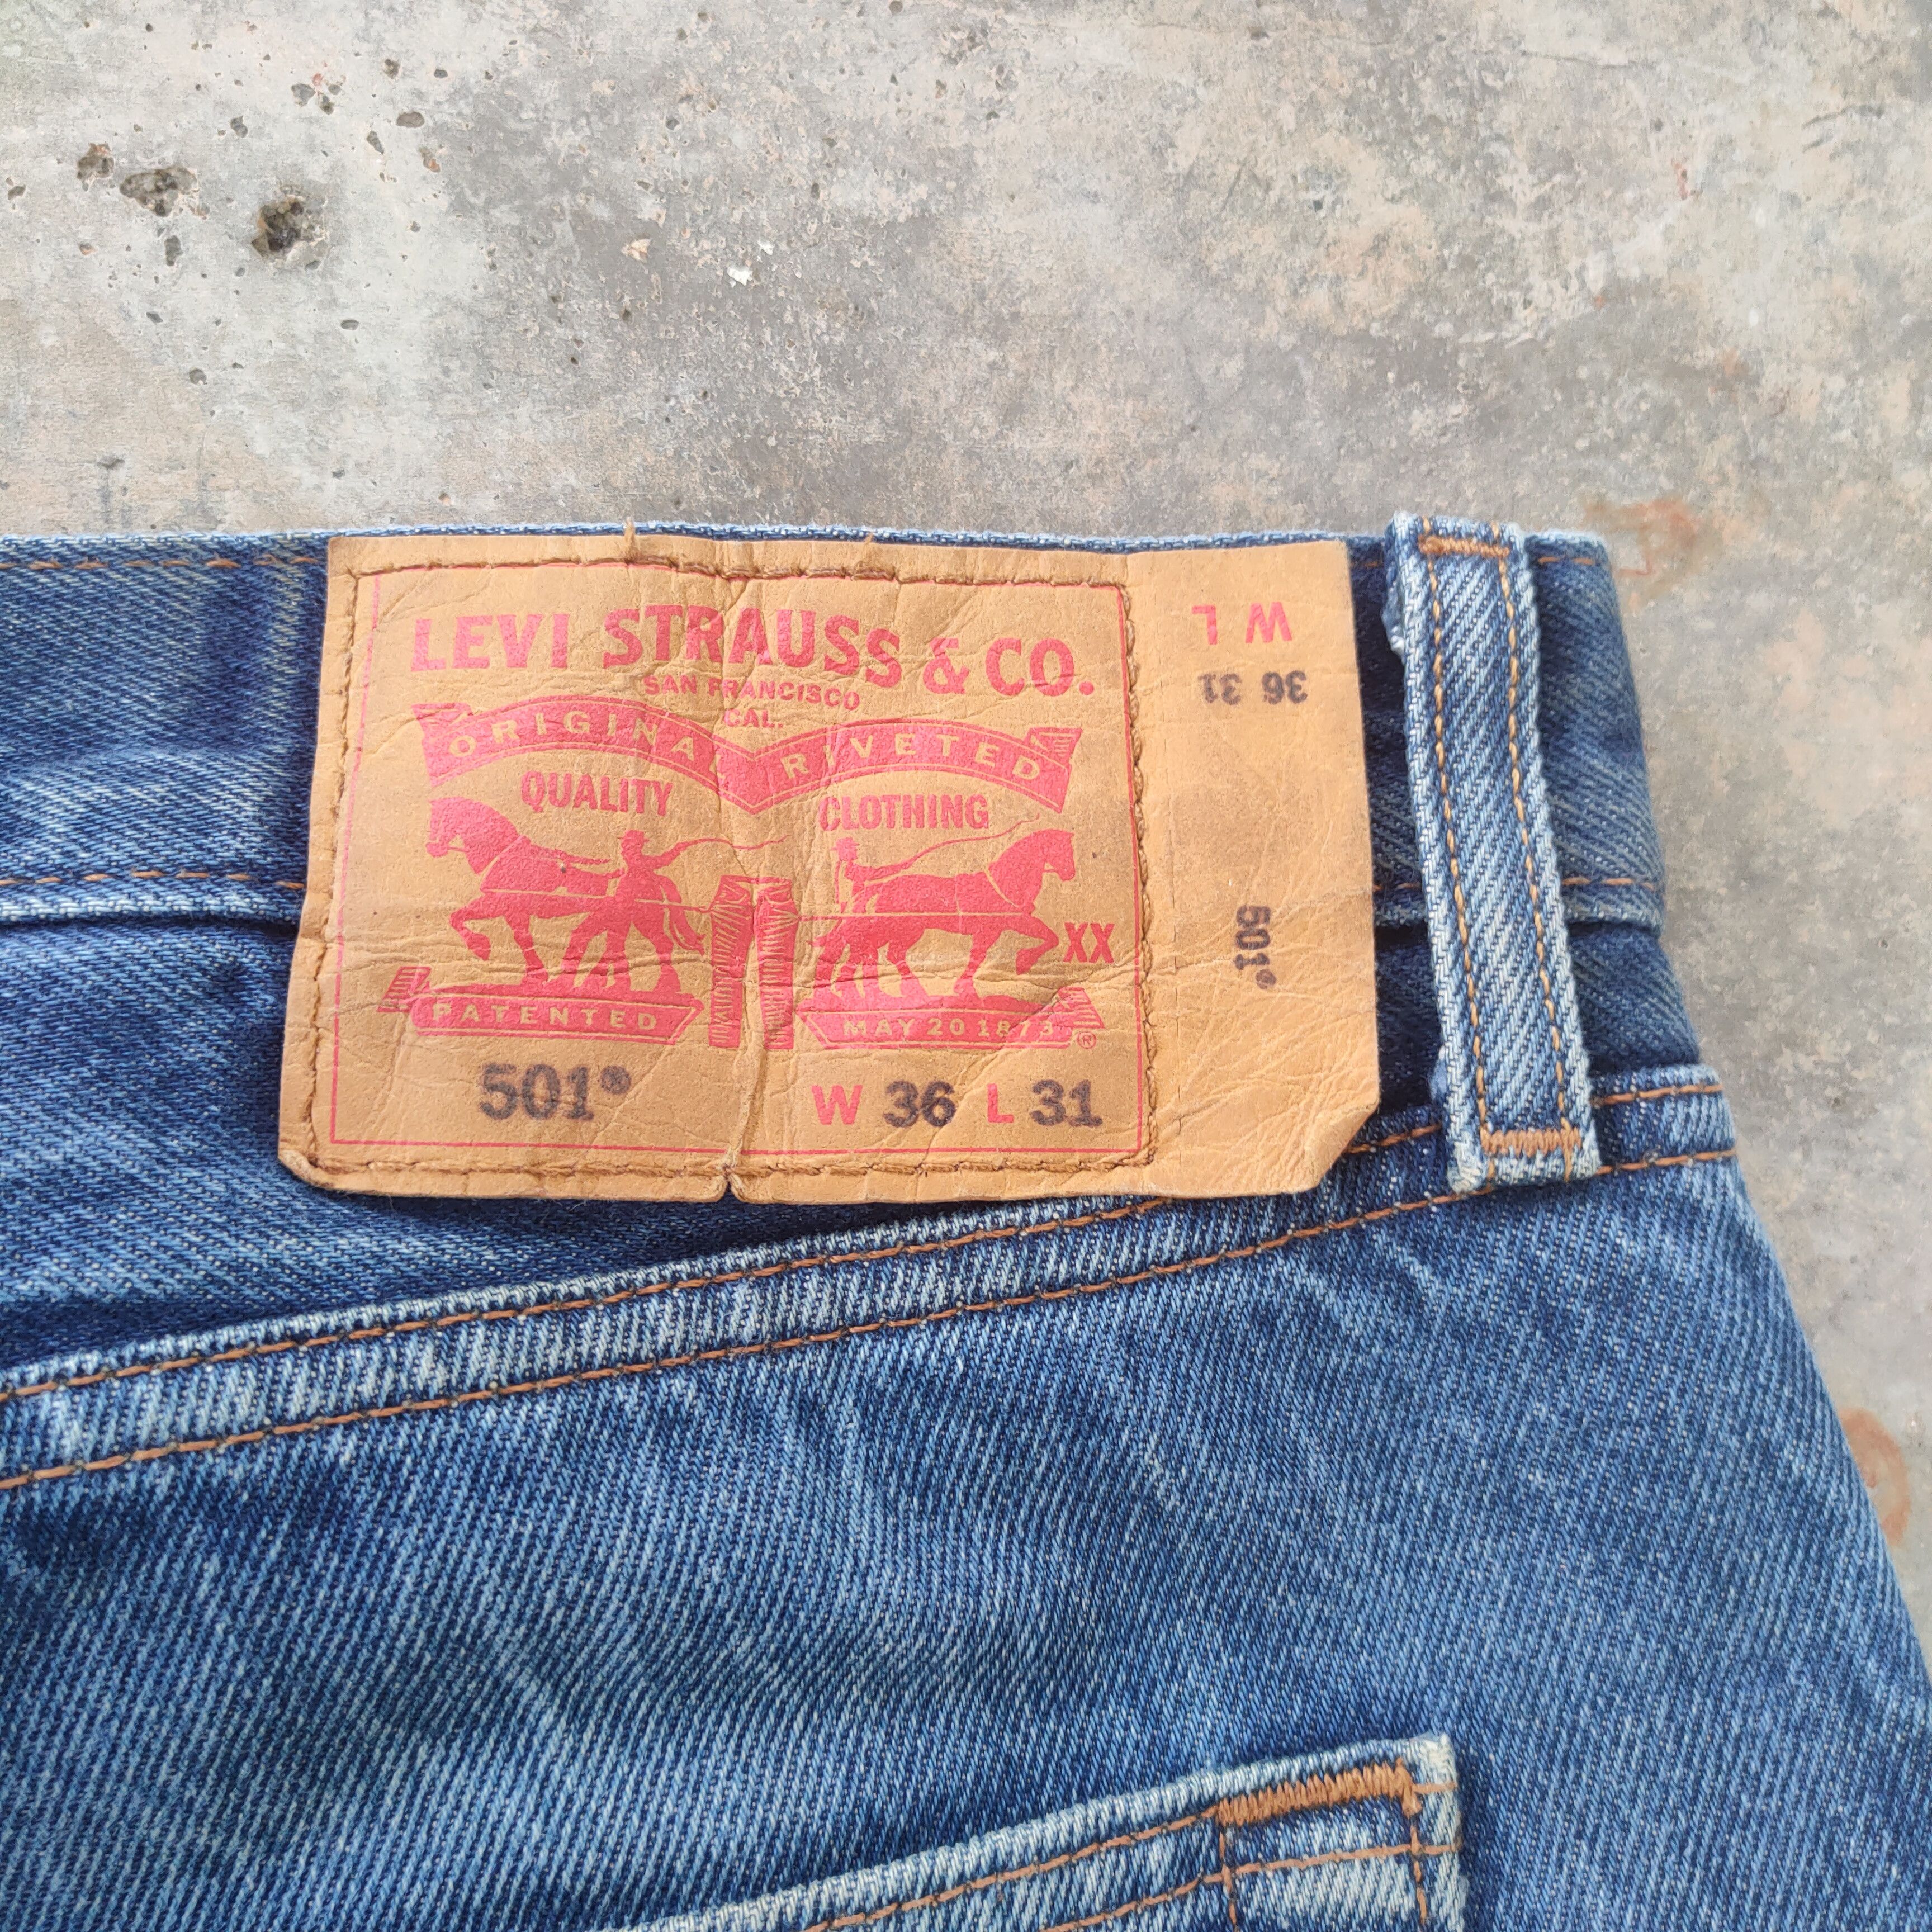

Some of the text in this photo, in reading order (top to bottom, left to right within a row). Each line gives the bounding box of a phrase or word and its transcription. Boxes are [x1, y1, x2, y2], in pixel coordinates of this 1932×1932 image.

[1191, 601, 1292, 645] W L
[411, 604, 1095, 697] LEVI STRAUSS & CO.
[643, 674, 860, 711] SAN FRANCISCO
[1197, 670, 1308, 705] 36 31
[779, 732, 1040, 780] RIVETED
[520, 771, 989, 831] QUALITY CLOTHING
[1063, 922, 1115, 963] XX
[432, 1003, 657, 1031] PATENTED
[843, 1017, 1054, 1039] MAY 20 1873
[811, 1079, 1103, 1128] W 36 L 31
